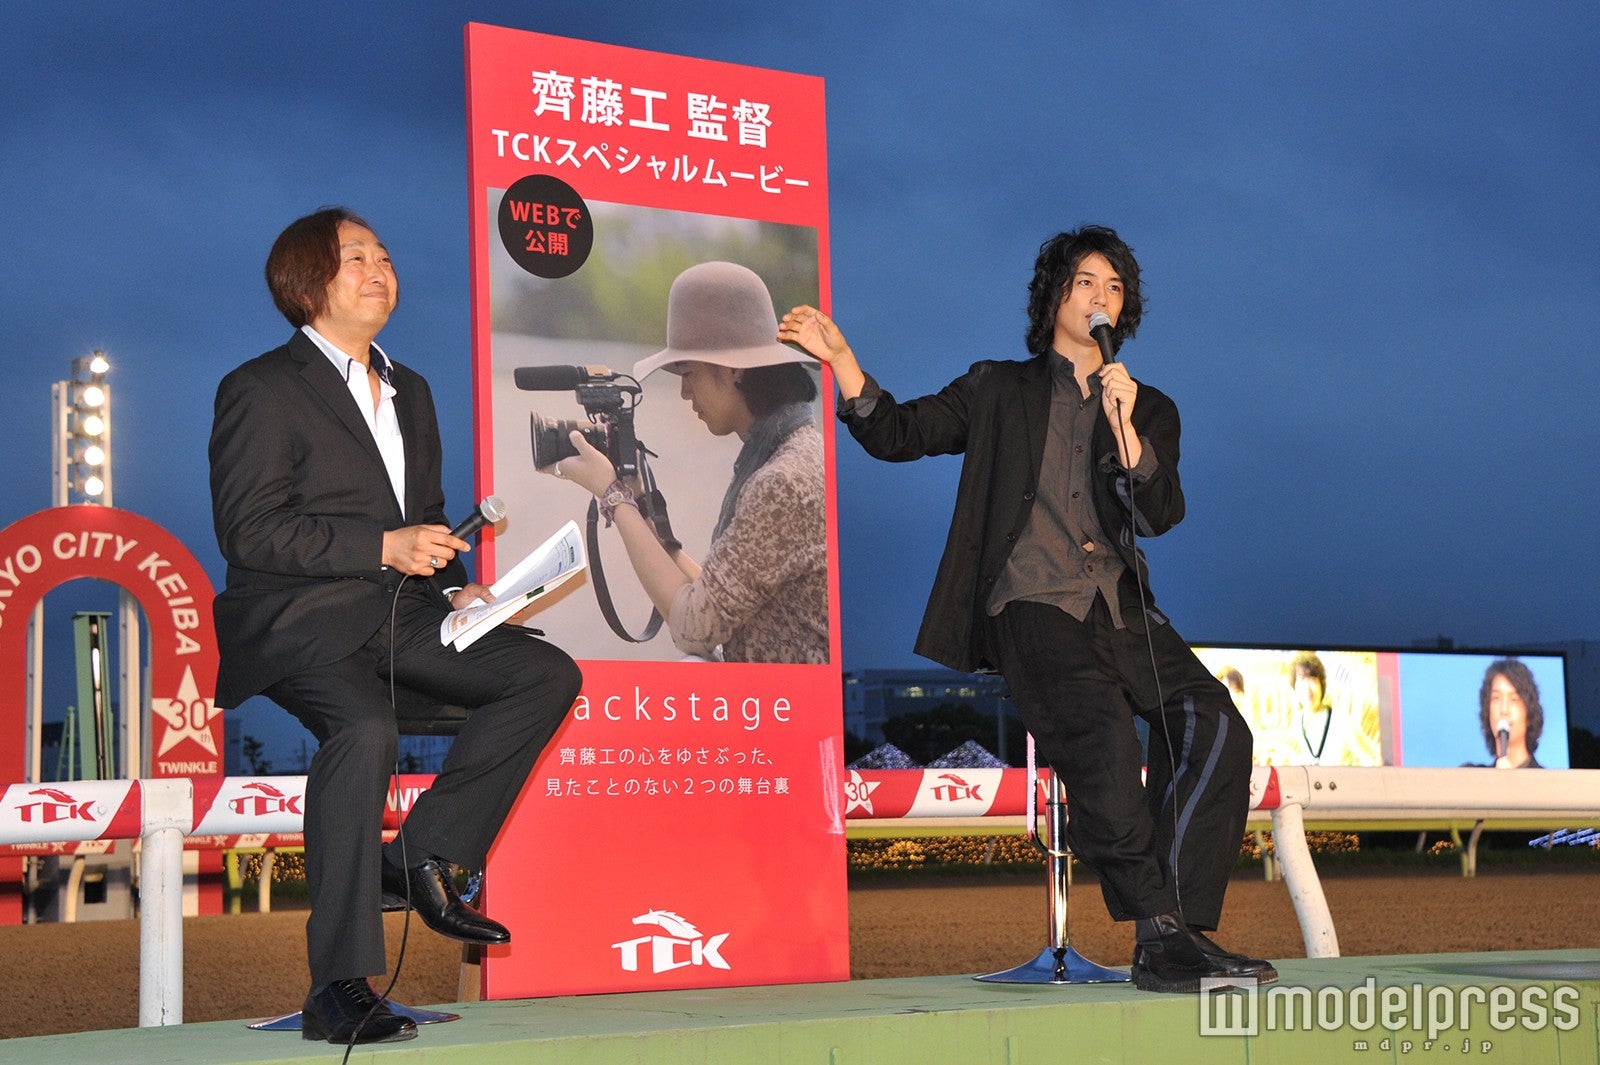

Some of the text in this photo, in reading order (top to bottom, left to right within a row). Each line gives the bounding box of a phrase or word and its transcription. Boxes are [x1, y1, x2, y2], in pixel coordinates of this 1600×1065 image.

[532, 70, 772, 148] 齊藤工 監督
[491, 128, 809, 194] TCKスペシャルムービー
[509, 200, 582, 230] WEBで
[525, 229, 569, 257] 公開
[53, 531, 138, 562] CITY
[137, 551, 201, 656] KEIBA
[169, 699, 207, 731] 30
[573, 686, 791, 731] ackstage
[158, 761, 217, 774] TWINKLE
[559, 747, 773, 766] 齊藤工の心をゆさぶった、
[545, 776, 790, 797] 見たことのない2つの舞台裏
[848, 782, 869, 802] 30
[930, 783, 984, 802] TCK
[14, 800, 96, 823] TCK
[229, 795, 303, 816] TCK
[611, 932, 731, 974] TCK
